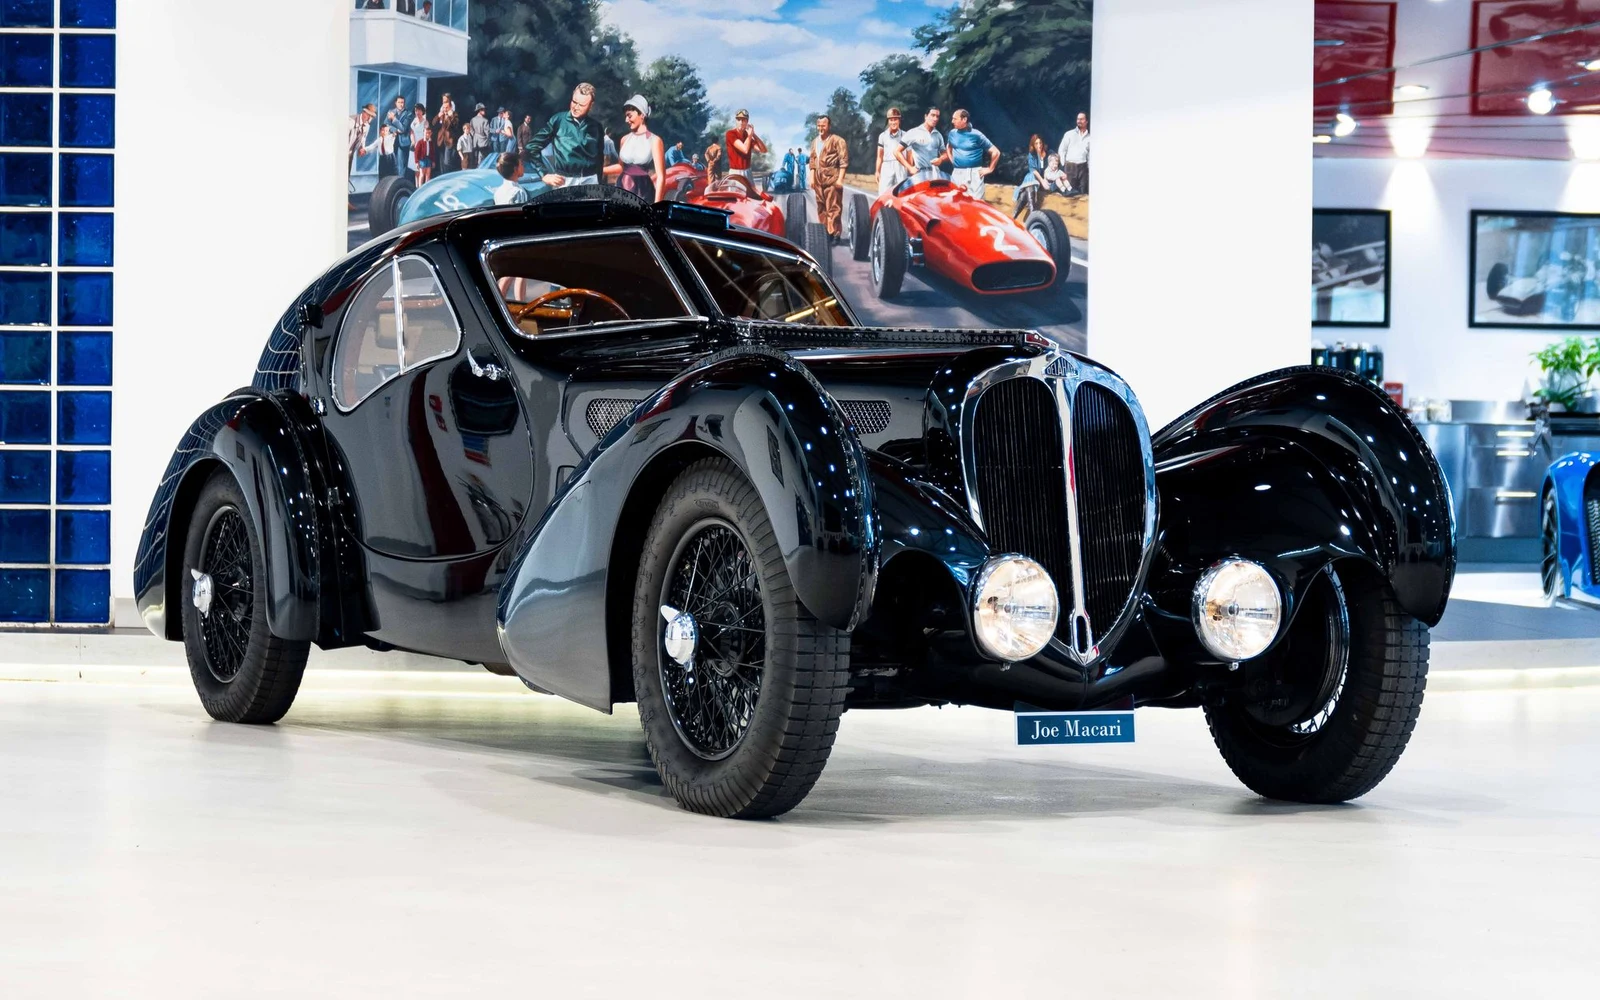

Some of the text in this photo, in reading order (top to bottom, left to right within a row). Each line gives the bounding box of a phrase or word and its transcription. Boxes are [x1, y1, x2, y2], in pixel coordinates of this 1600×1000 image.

[980, 225, 1019, 252] 2
[1046, 357, 1078, 377] DELAH
[1031, 719, 1122, 740] Joe Macari
